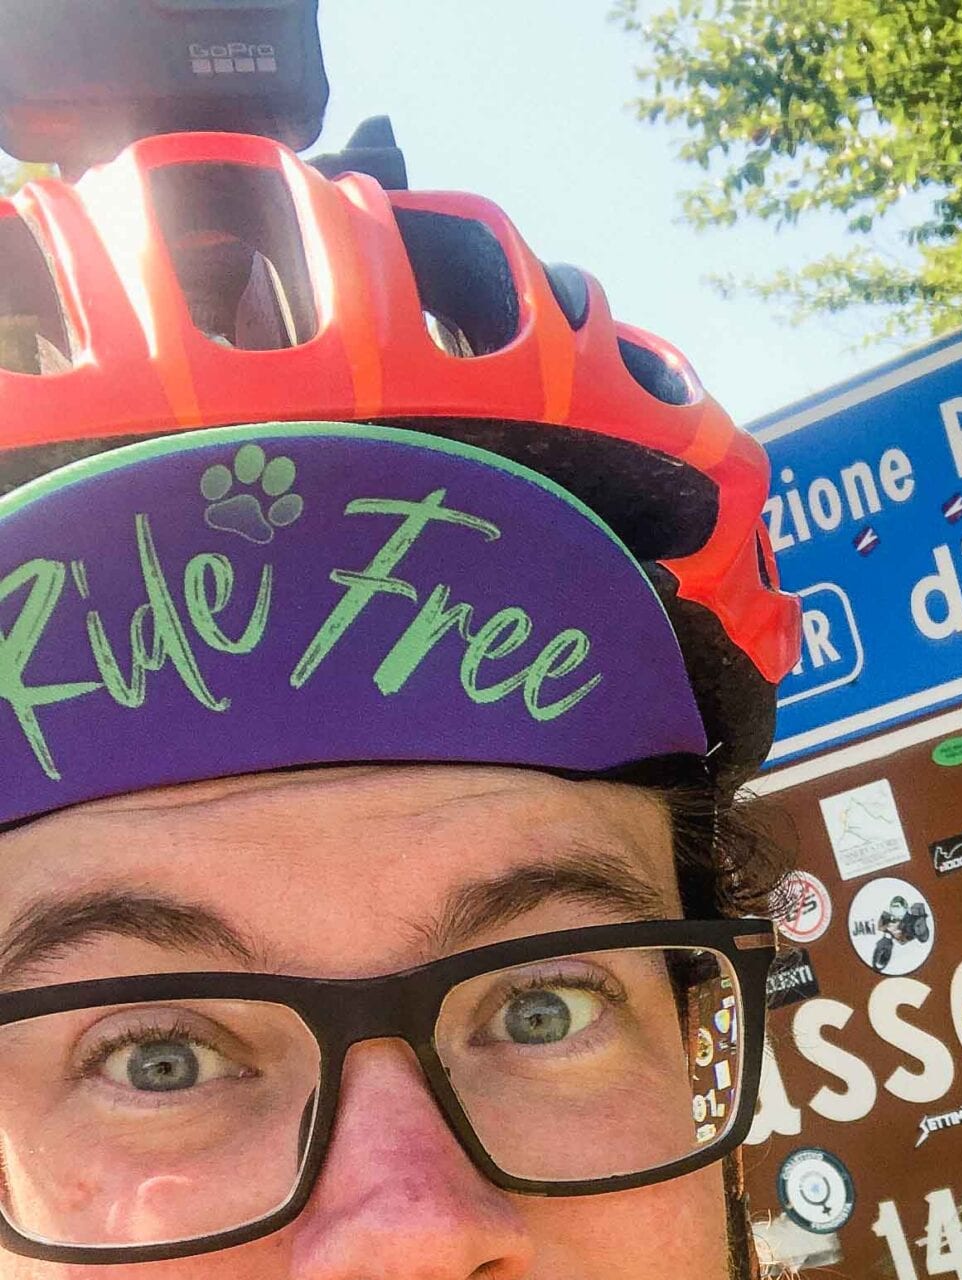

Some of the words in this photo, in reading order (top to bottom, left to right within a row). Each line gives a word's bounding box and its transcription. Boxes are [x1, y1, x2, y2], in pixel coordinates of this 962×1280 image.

[187, 42, 274, 58] GoPro
[0, 513, 273, 781] Ride
[291, 488, 603, 722] Free
